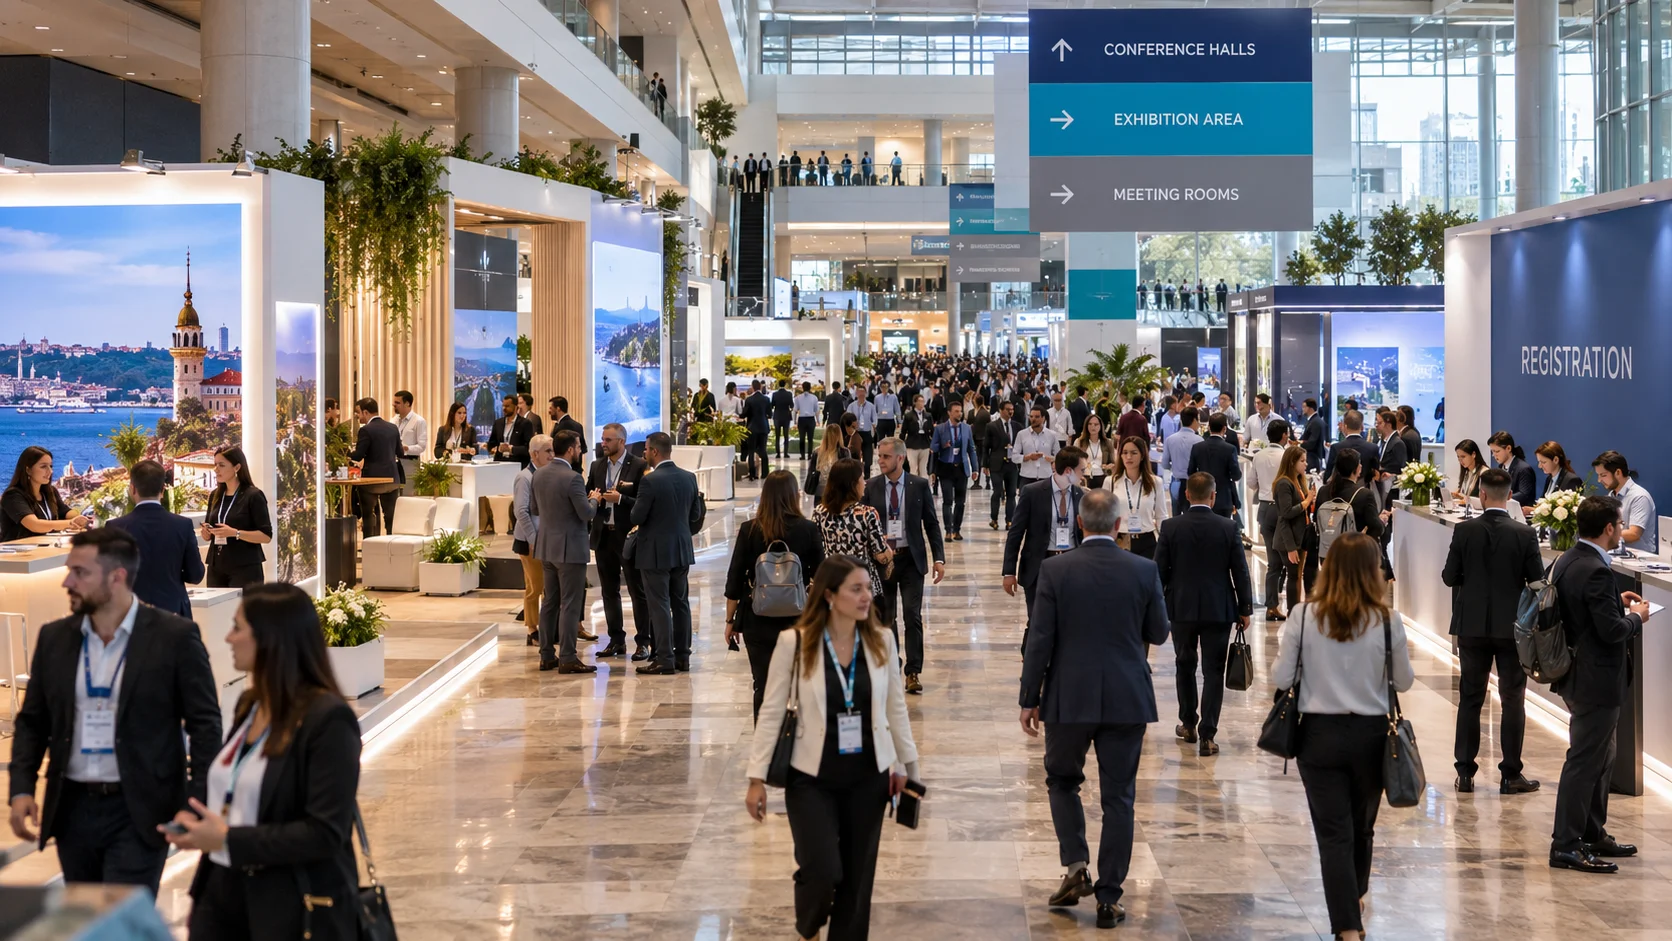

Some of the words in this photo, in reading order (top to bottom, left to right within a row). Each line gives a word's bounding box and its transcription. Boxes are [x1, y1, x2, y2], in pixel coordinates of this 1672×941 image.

[1104, 43, 1205, 56] CONFERENCE
[1209, 43, 1256, 56] HALLS
[1114, 113, 1199, 126] EXHIBITION
[1203, 113, 1244, 126] AREA
[1113, 188, 1180, 201] MEETING
[1184, 188, 1239, 201] ROOMS
[1521, 345, 1632, 380] REGISTRATION
